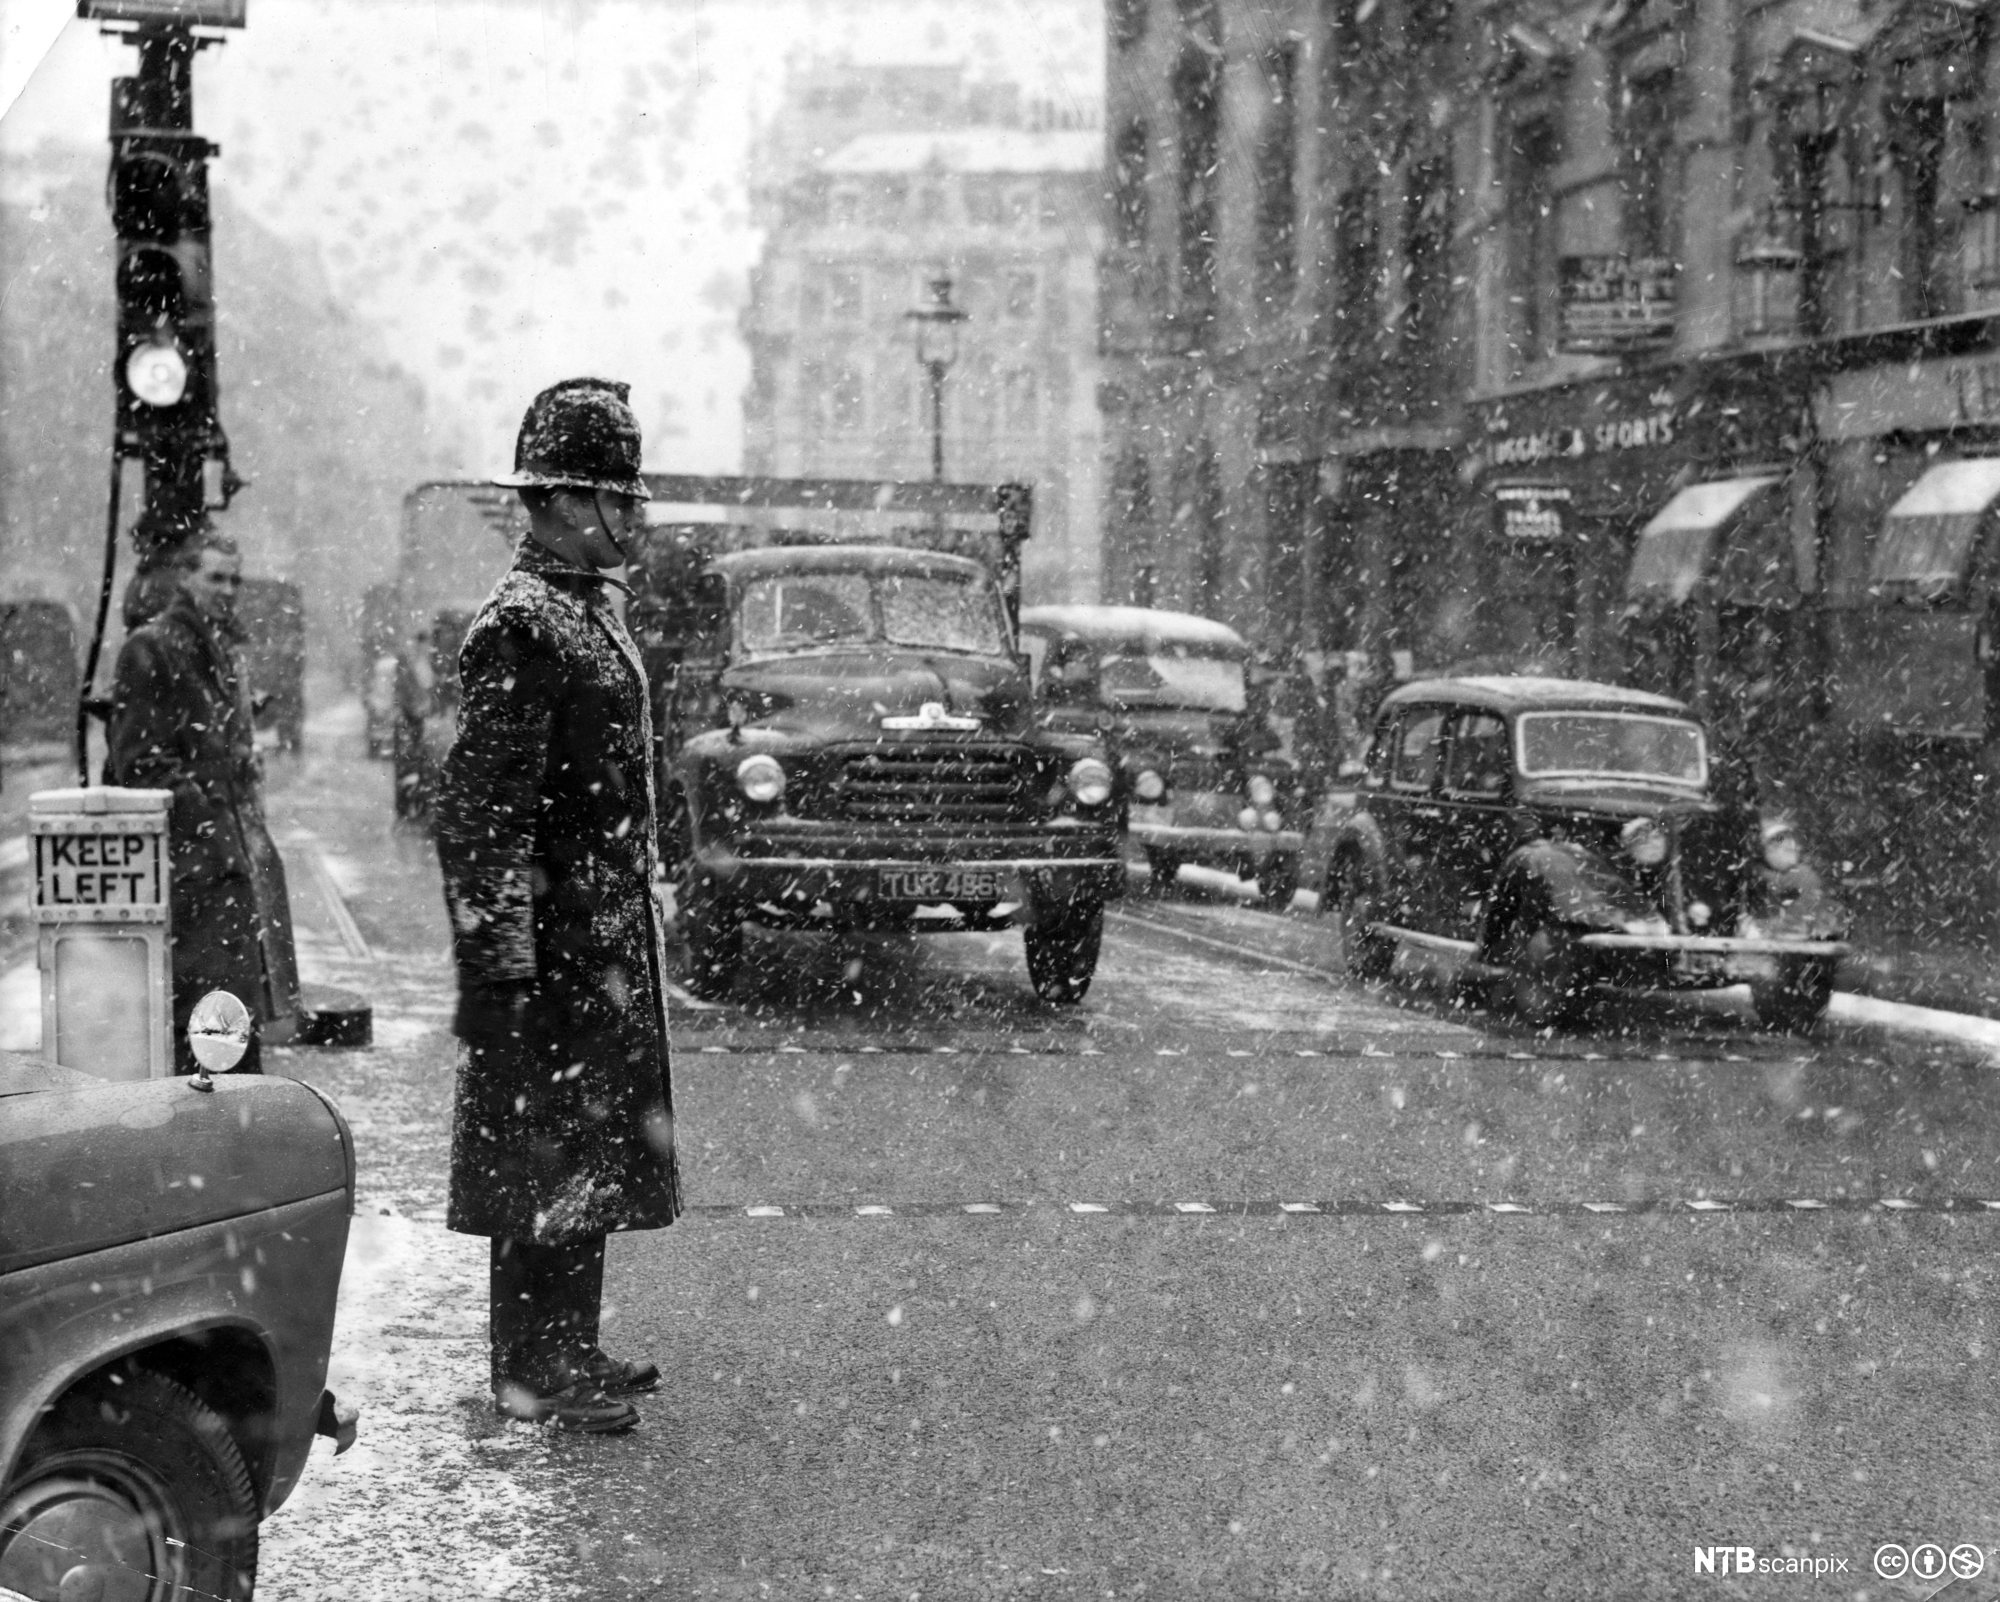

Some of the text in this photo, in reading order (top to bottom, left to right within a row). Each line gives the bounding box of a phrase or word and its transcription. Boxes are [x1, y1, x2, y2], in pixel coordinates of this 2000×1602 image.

[1595, 412, 1673, 452] SPORTS
[52, 834, 144, 866] KEEP
[53, 873, 145, 904] LEFT
